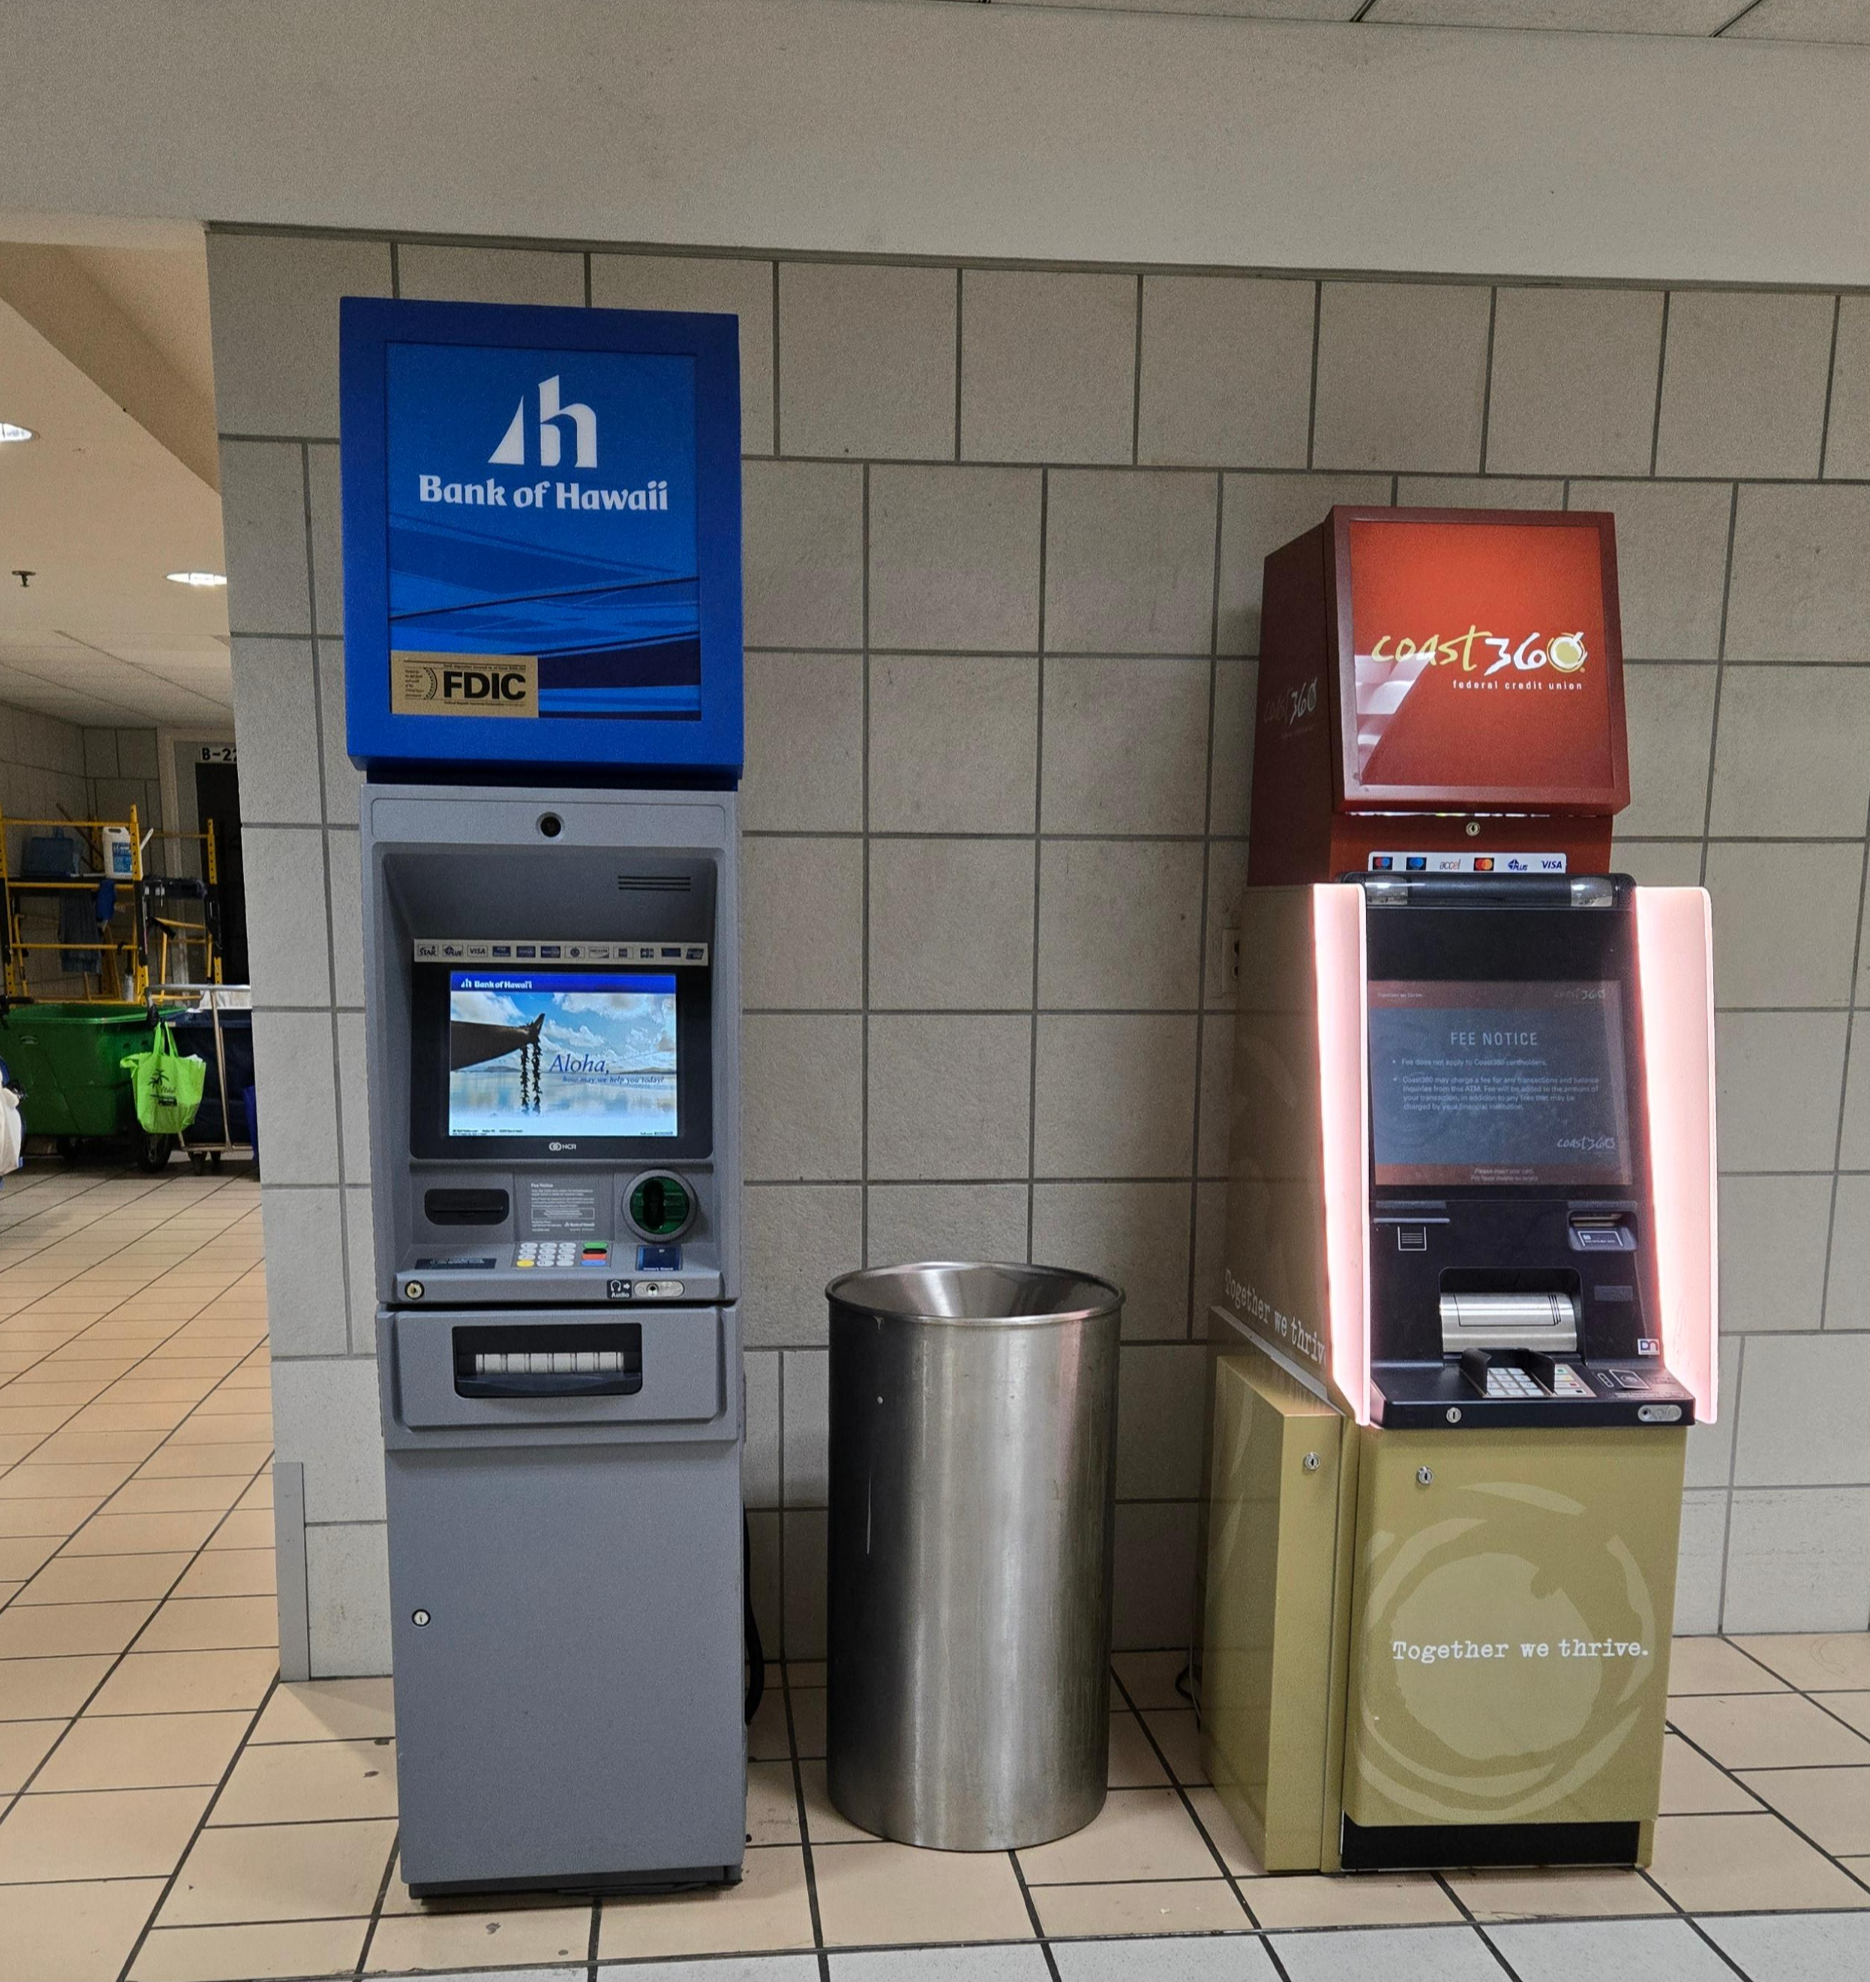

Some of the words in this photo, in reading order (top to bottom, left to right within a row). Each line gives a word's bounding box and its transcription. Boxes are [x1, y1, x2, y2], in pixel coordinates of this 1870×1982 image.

[419, 474, 507, 506] Bank
[513, 480, 551, 508] of
[555, 480, 669, 510] Hawaii
[443, 670, 526, 700] FDIC
[1453, 679, 1498, 690] federal
[1505, 679, 1543, 690] credit
[1548, 681, 1583, 690] union
[1439, 858, 1461, 870] accel
[1541, 860, 1562, 869] VISA
[469, 947, 486, 955] VISA
[474, 980, 494, 989] Bank
[495, 980, 503, 988] of
[1450, 1031, 1476, 1046] FEE
[1483, 1031, 1538, 1046] NOTICE
[549, 1053, 610, 1076] Aloha,
[1446, 1059, 1464, 1067] apply
[563, 1076, 579, 1084] how
[609, 1076, 625, 1085] help
[626, 1078, 642, 1086] you
[641, 1076, 665, 1086] today?
[1434, 1077, 1449, 1085] may
[561, 1143, 577, 1151] NCR
[1557, 1136, 1616, 1150] coast360
[611, 1291, 630, 1299] Audio
[1224, 1268, 1271, 1324] Together
[1274, 1310, 1288, 1337] we
[1290, 1316, 1327, 1366] thriv
[1392, 1640, 1509, 1664] Together
[1520, 1642, 1550, 1658] we
[1558, 1638, 1649, 1658] thrive.
